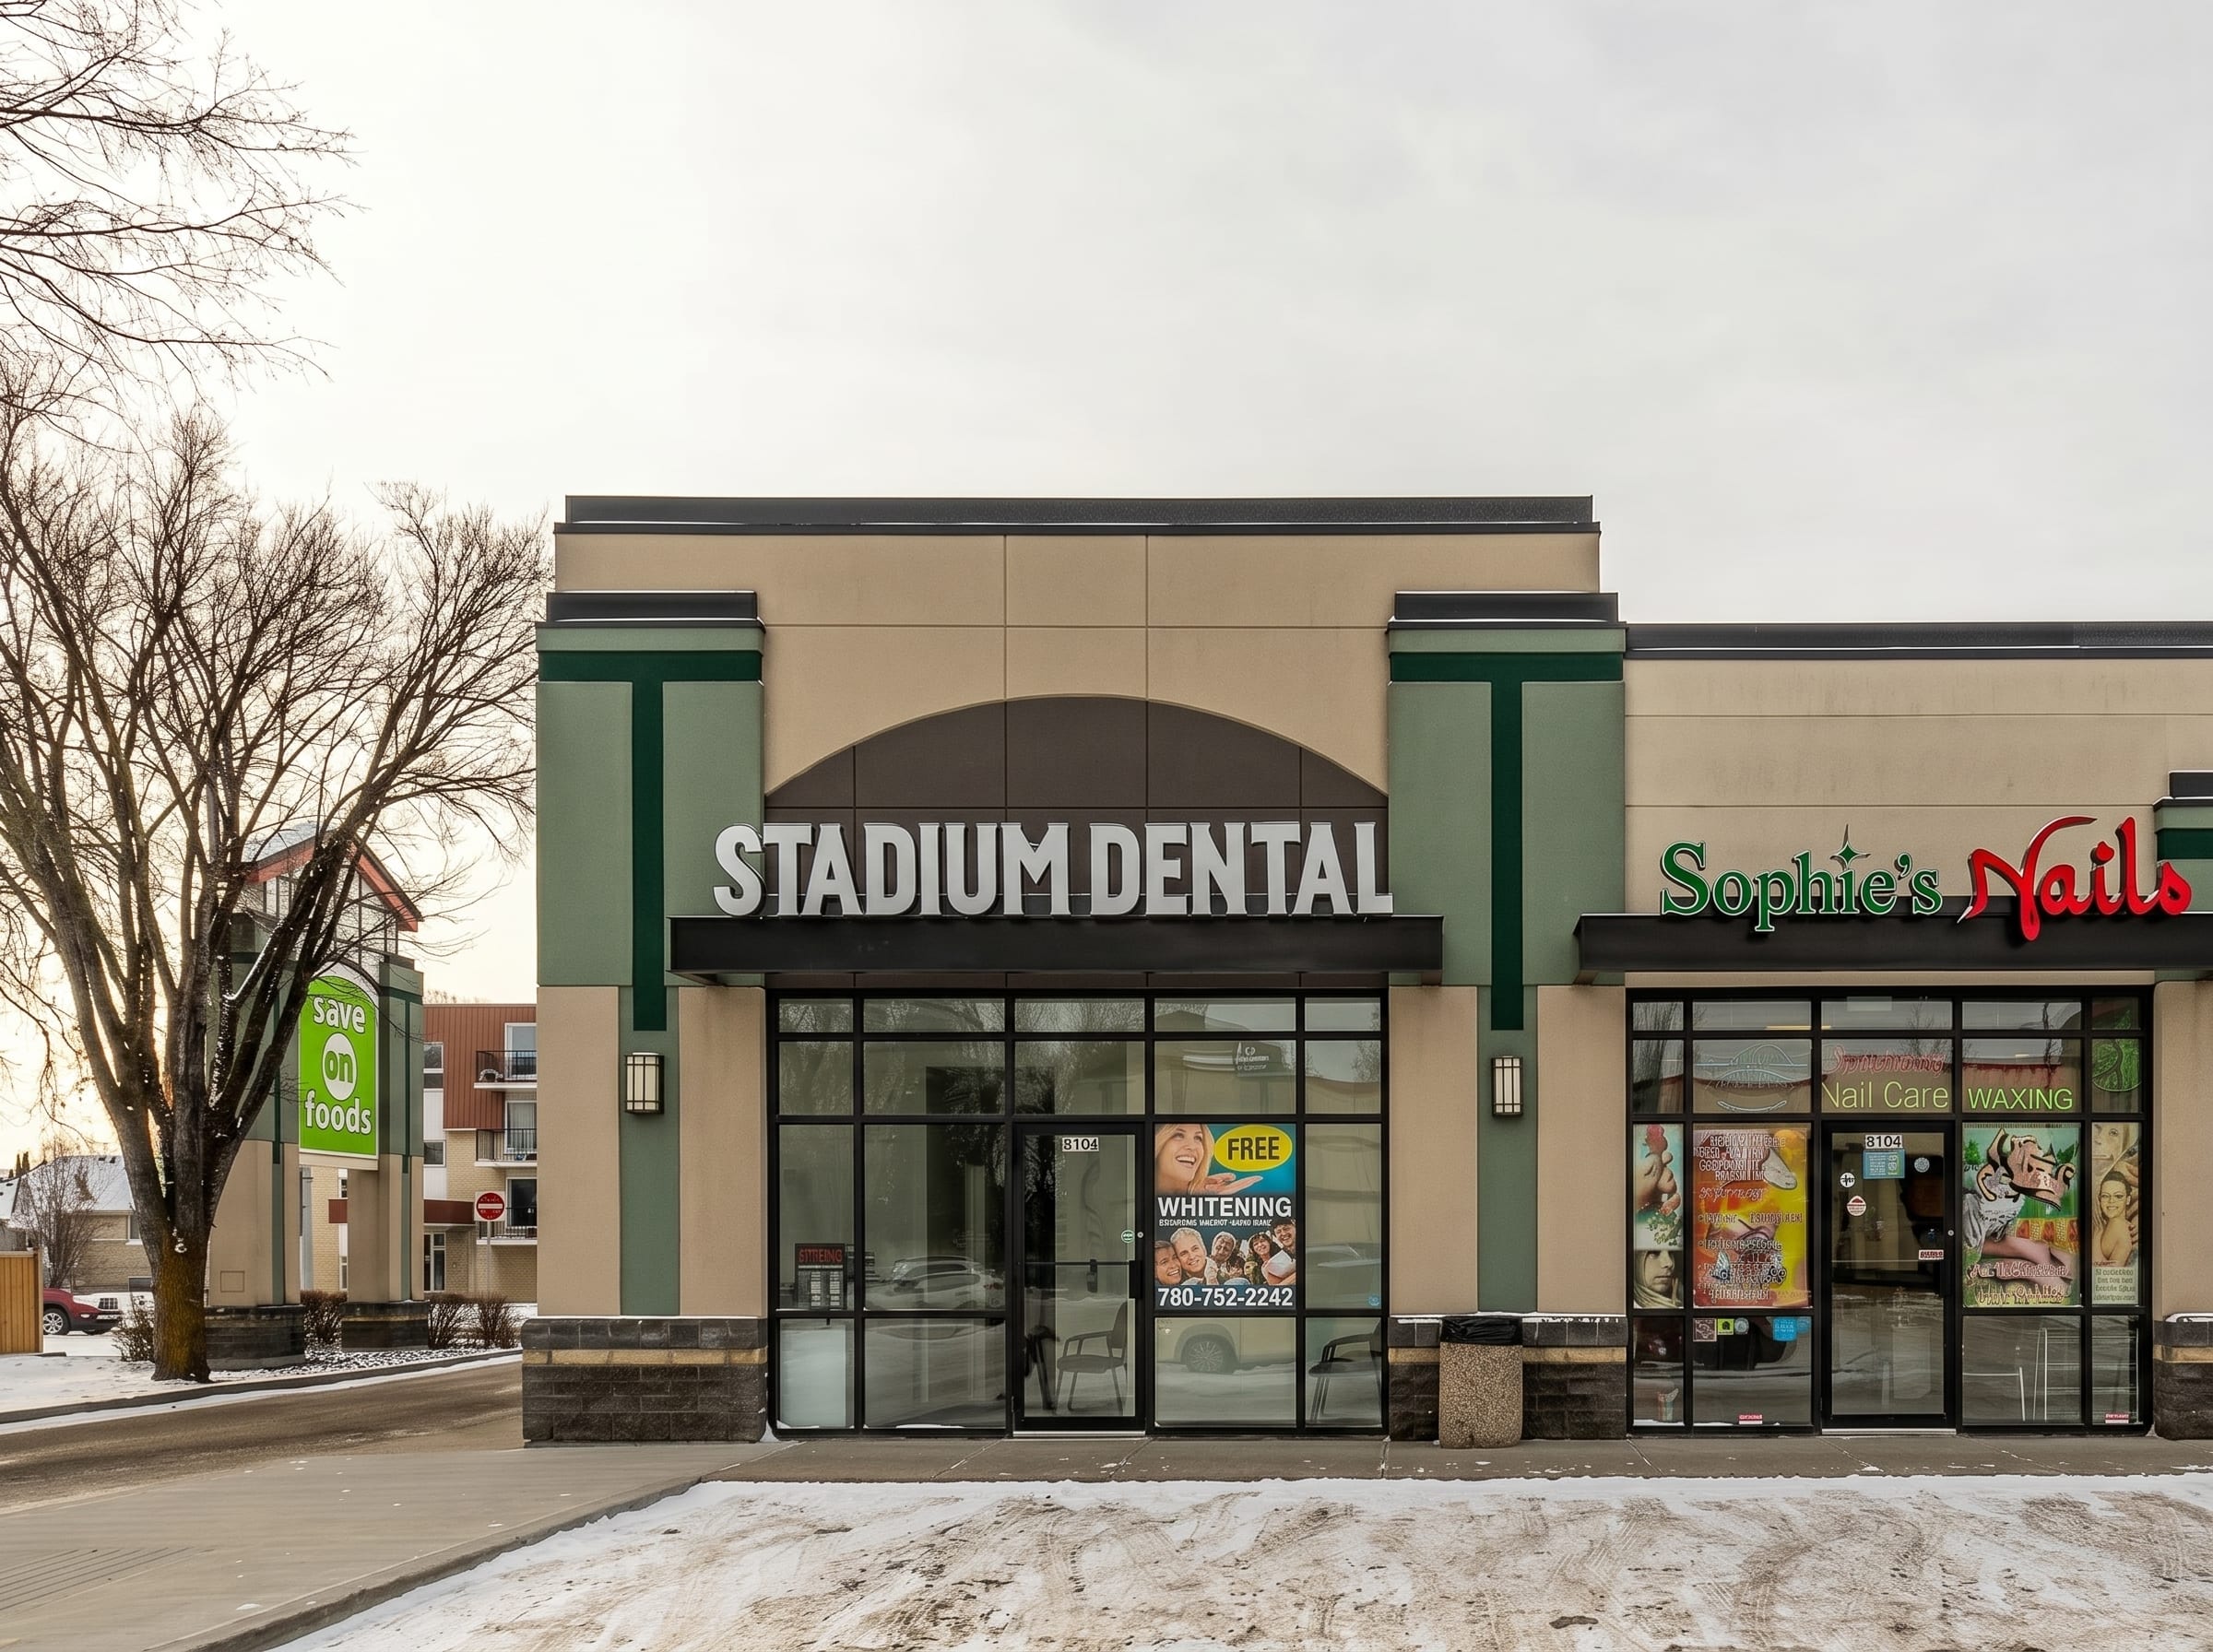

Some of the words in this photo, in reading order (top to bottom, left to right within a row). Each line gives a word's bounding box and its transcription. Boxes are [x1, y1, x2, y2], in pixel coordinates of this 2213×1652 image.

[713, 820, 1072, 917] STADIUM
[1089, 820, 1394, 916] DENTAL
[1660, 830, 1944, 933] Sophie's
[1958, 816, 2194, 942] Nails
[313, 995, 366, 1033] save
[325, 1050, 354, 1084] on
[1822, 1080, 1873, 1109] Nail
[1884, 1080, 1948, 1109] Care
[1968, 1088, 2074, 1110] WAXING
[305, 1090, 373, 1135] foods
[1227, 1137, 1280, 1161] FREE
[1866, 1135, 1902, 1148] 8104
[1157, 1197, 1292, 1217] WHITENING
[1157, 1287, 1293, 1306] 780-752-2242
